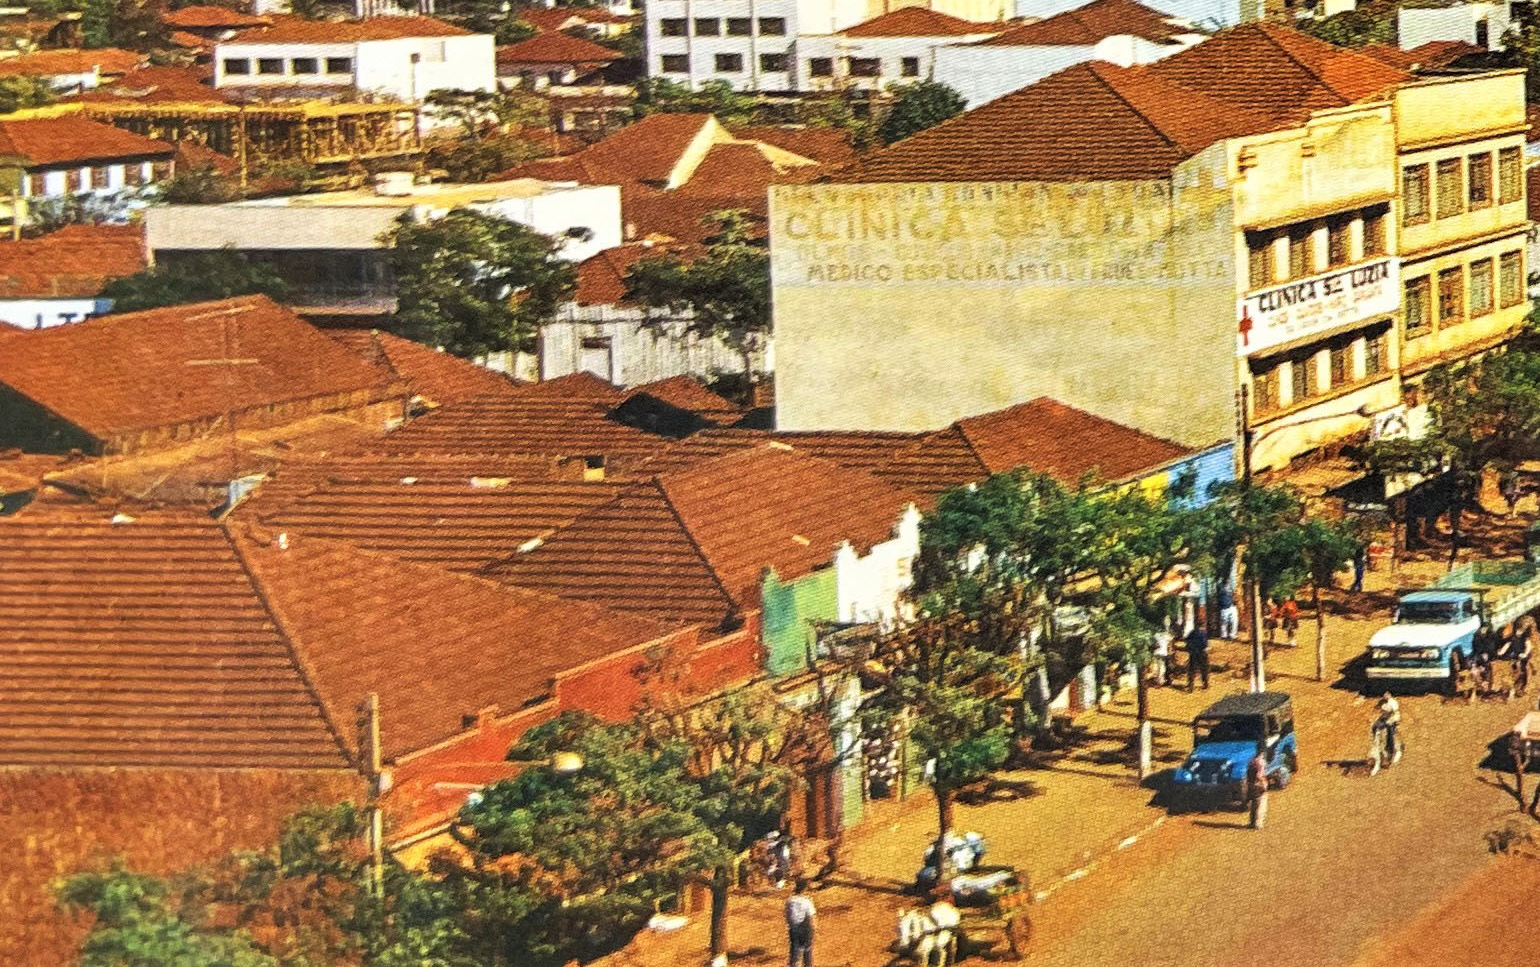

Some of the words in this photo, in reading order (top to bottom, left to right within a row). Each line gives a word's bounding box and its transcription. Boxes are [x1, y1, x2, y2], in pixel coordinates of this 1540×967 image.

[807, 263, 892, 282] MEDICO
[1257, 280, 1317, 314] CLINICA
[1350, 260, 1391, 289] LUZIA
